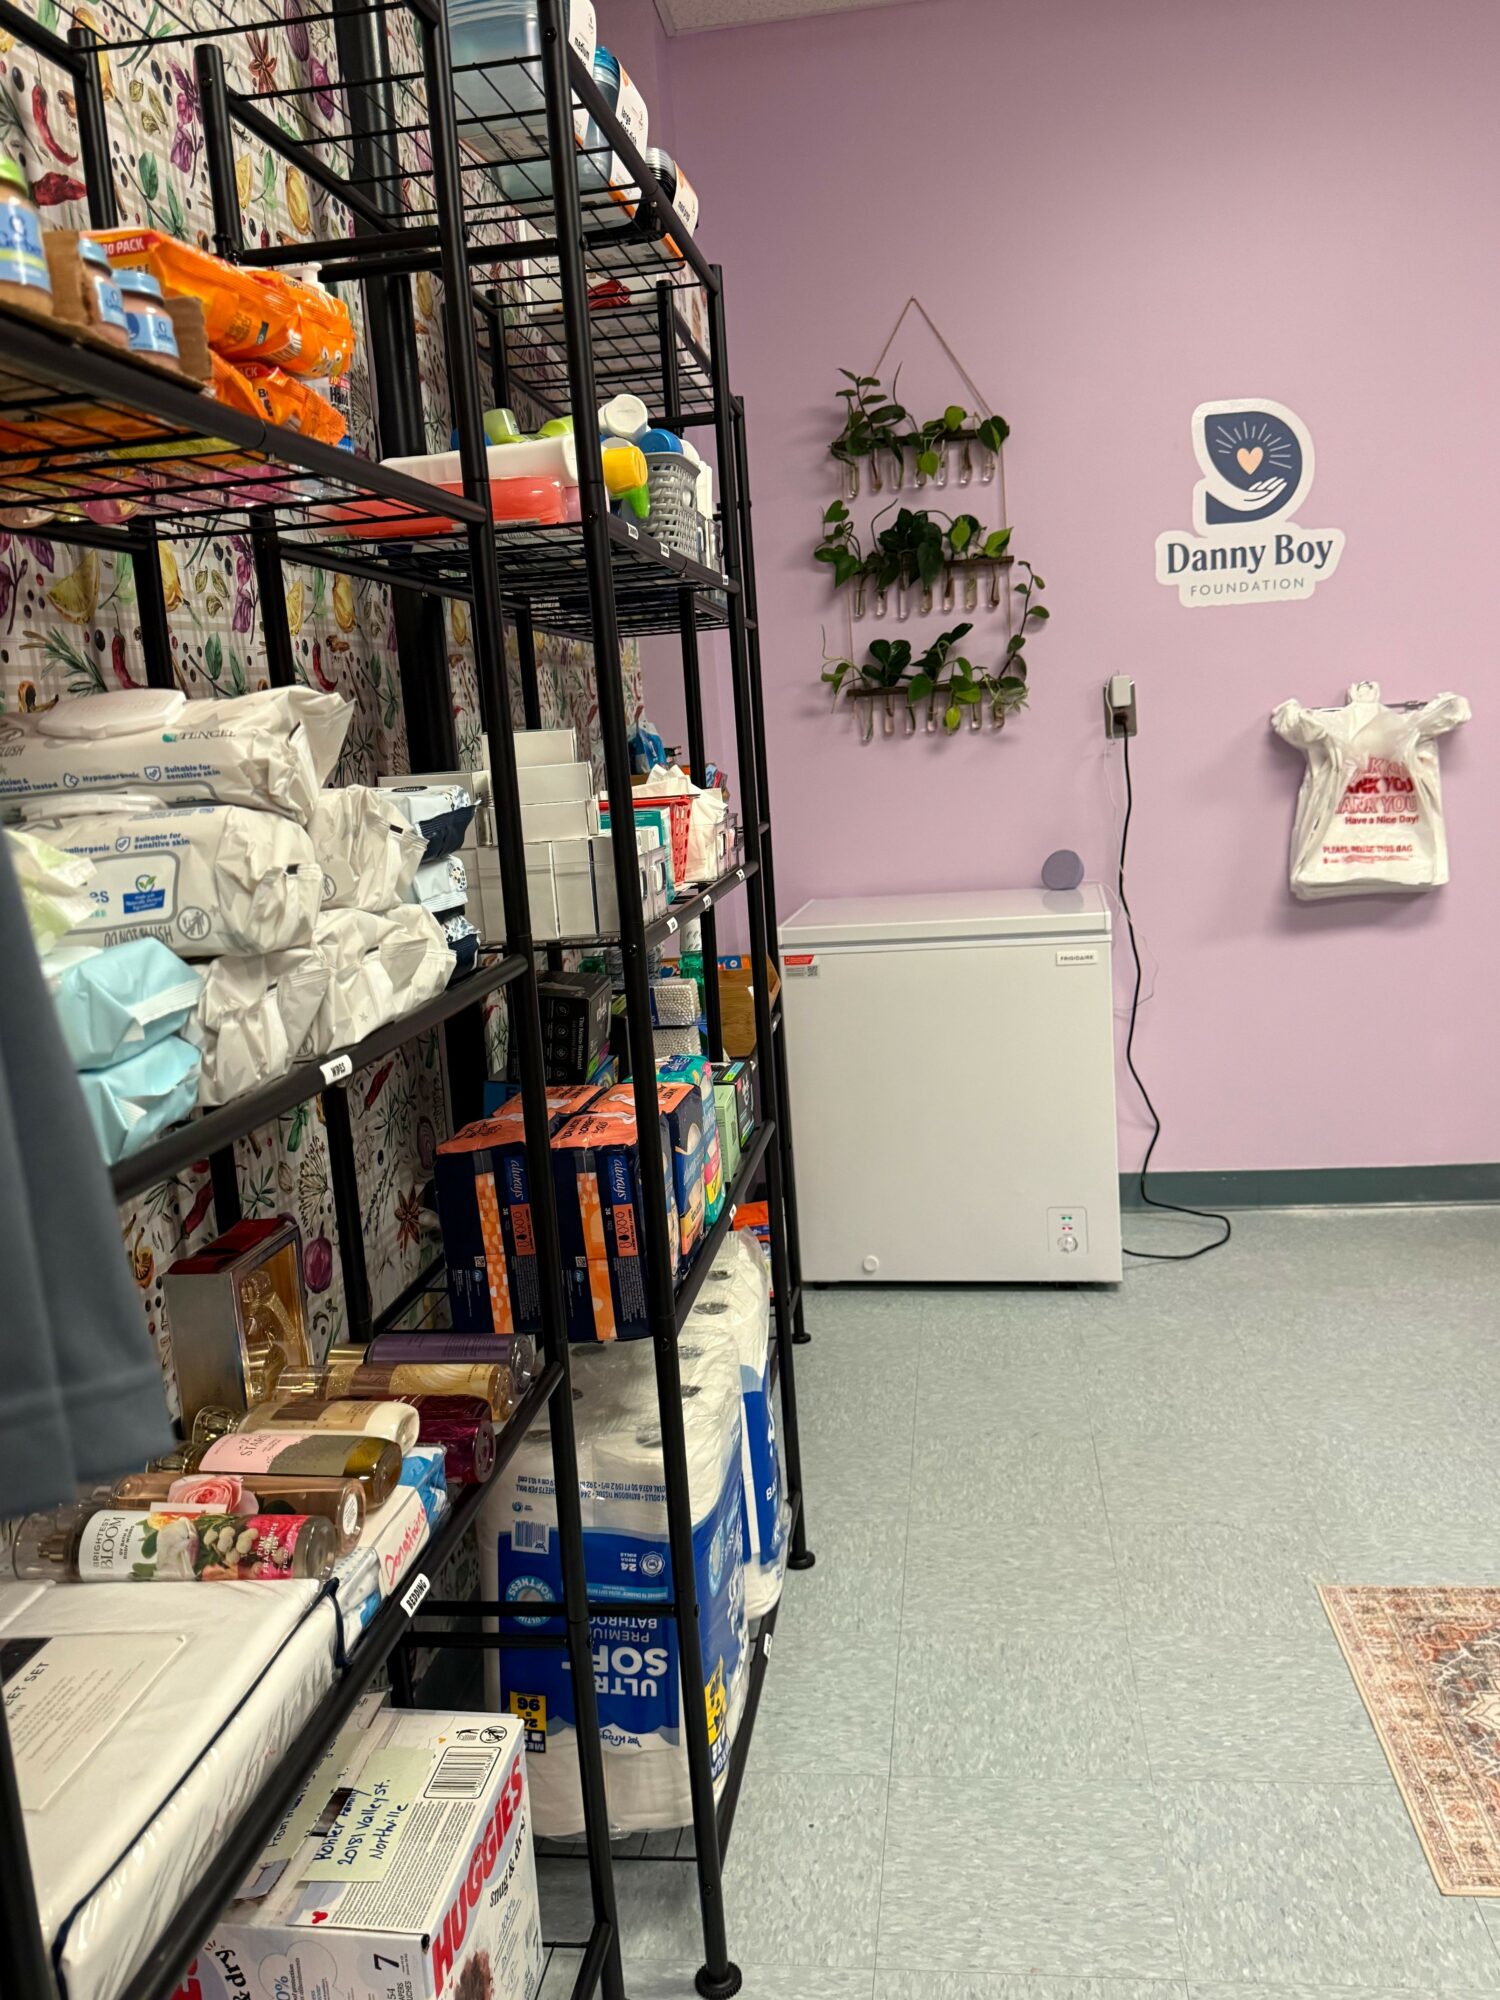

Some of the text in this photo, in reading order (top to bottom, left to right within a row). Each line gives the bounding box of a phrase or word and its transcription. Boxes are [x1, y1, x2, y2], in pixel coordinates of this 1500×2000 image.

[116, 238, 144, 253] PACK
[1167, 534, 1334, 574] Danny Boy
[1190, 577, 1305, 597] FOUNDATION
[164, 763, 211, 774] Suitable for
[166, 772, 202, 780] sensitive
[1382, 776, 1414, 794] YOU
[1335, 795, 1418, 814] ANK YOU
[1345, 817, 1367, 825] Have
[1376, 816, 1397, 824] Nice
[1398, 815, 1419, 825] Day!
[134, 832, 181, 843] Suitable for
[134, 838, 190, 850] sensitive skin
[1395, 844, 1413, 852] BAG
[104, 933, 118, 948] DO
[120, 930, 138, 944] NOT
[330, 1062, 346, 1077] WIPES
[511, 1159, 524, 1200] always
[614, 1159, 627, 1200] always
[515, 1484, 528, 1493] ROLL
[580, 1490, 592, 1498] 244
[614, 1491, 641, 1500] BATHROOM
[645, 1493, 661, 1501] ROLLS
[93, 1517, 110, 1568] BRIGHTEST
[101, 1516, 127, 1569] BLOOM
[257, 1535, 266, 1556] FINE
[262, 1522, 279, 1574] FRAGRANCE
[271, 1535, 279, 1557] MIST
[621, 1562, 637, 1572] 24
[406, 1579, 428, 1611] BEDDING
[508, 1576, 553, 1601] SOFTNESS
[590, 1627, 650, 1643] PREMIU
[24, 1661, 50, 1683] SET
[594, 1676, 658, 1697] ULTR
[517, 1697, 540, 1711] 96
[337, 1833, 366, 1865] 20181
[357, 1796, 390, 1831] Valley
[369, 1803, 409, 1860] Northville
[489, 1817, 527, 1908] Snug & dry
[431, 1753, 523, 1999] HUGGIES
[215, 1949, 248, 1988] dry
[373, 1953, 400, 1971] 7
[274, 1975, 291, 2000] 0%
[386, 1987, 397, 2000] 54
